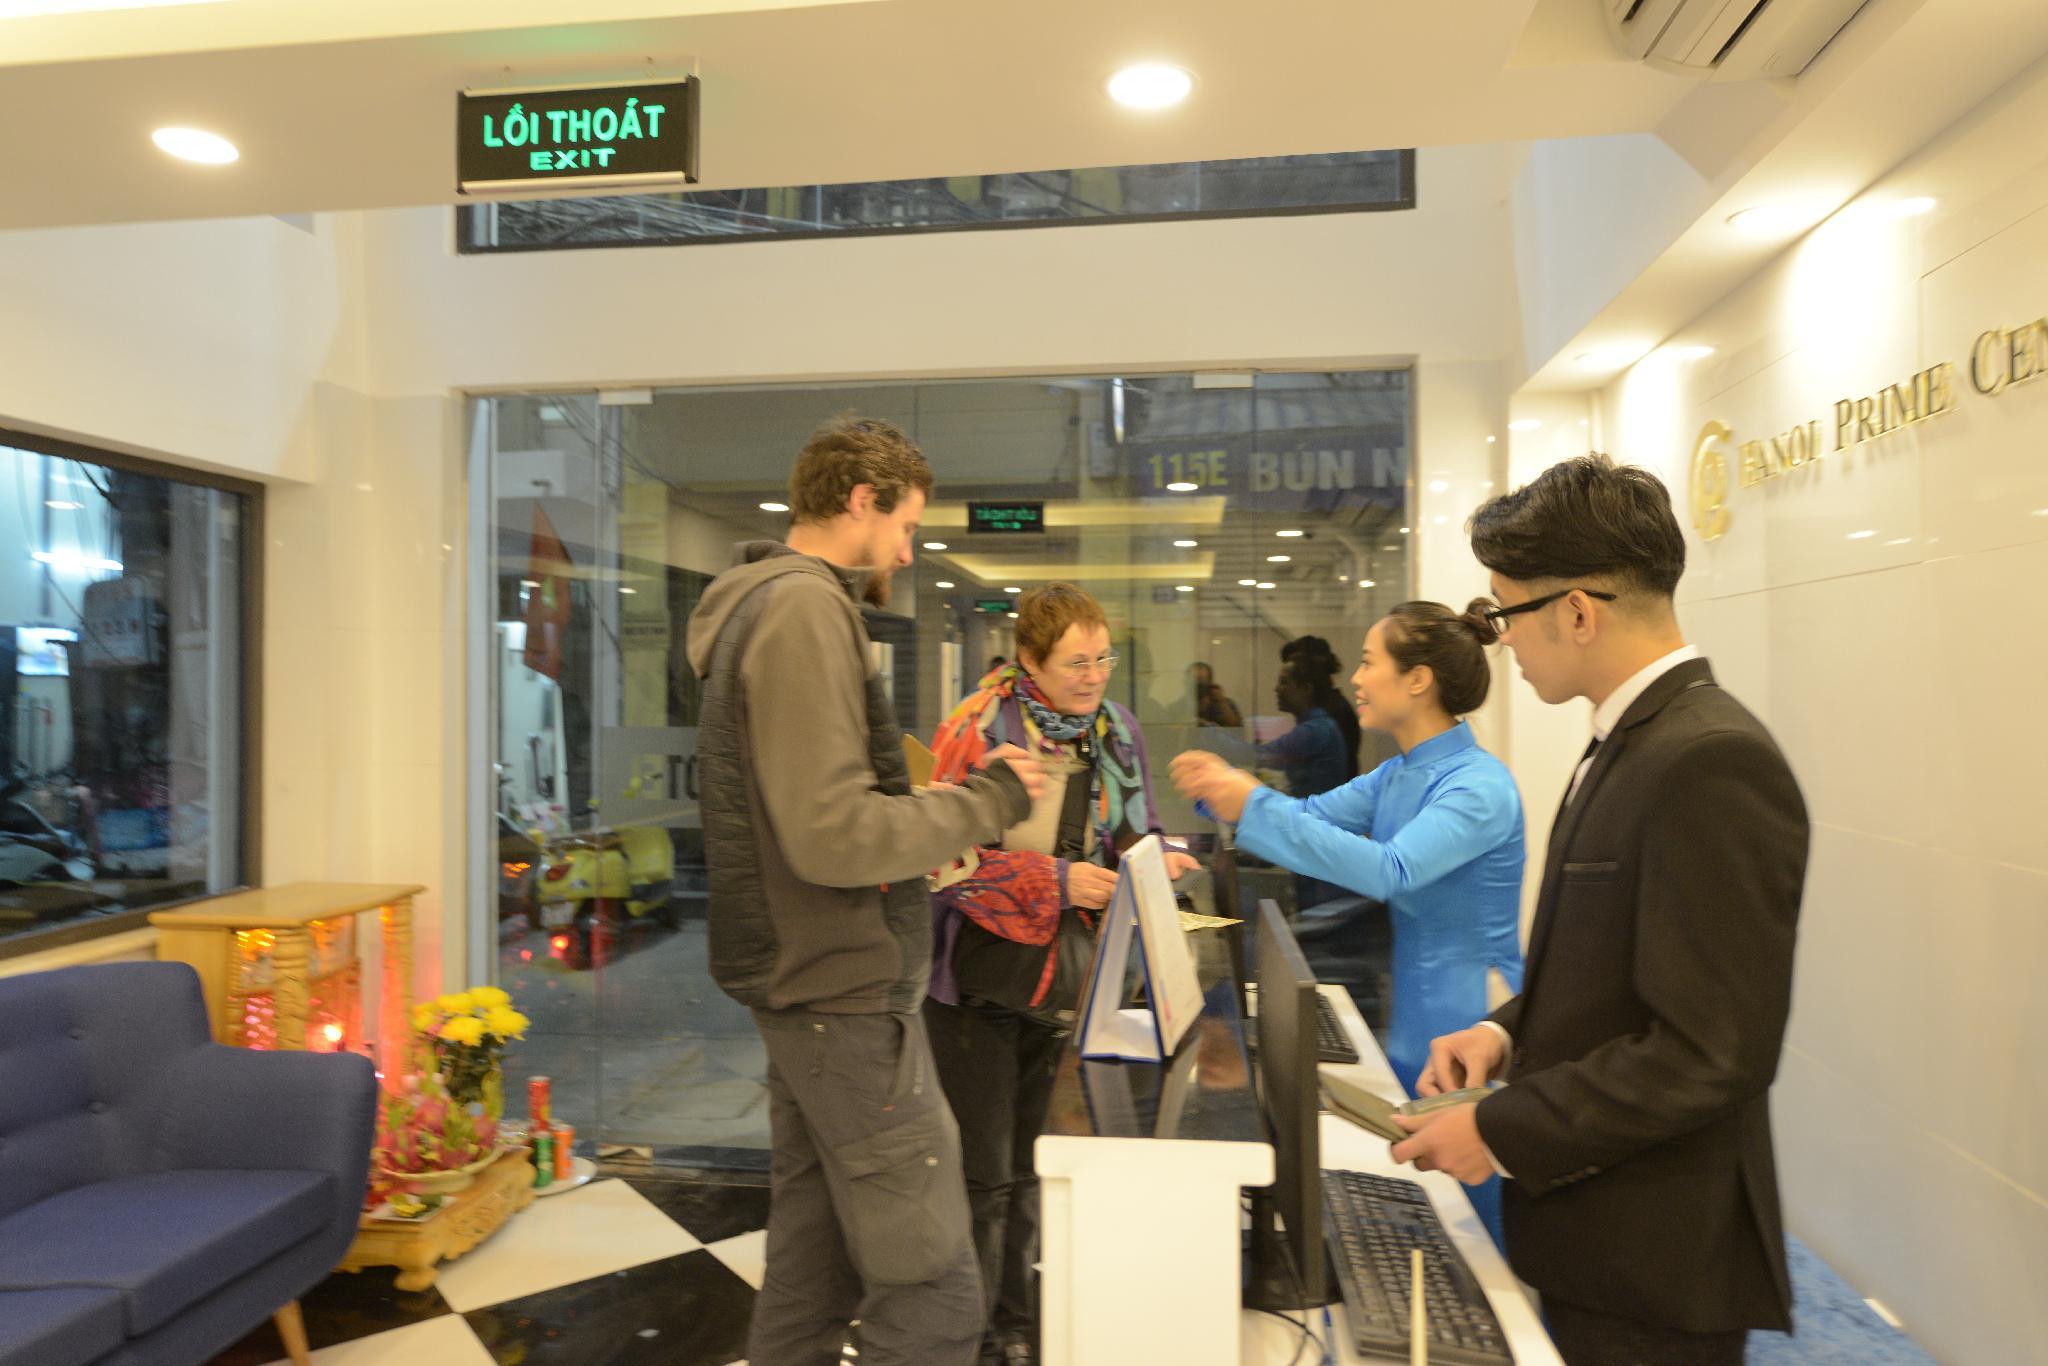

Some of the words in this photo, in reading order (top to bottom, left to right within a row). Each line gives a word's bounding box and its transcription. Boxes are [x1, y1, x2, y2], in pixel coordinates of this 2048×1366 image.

[546, 98, 665, 143] THOÁT
[530, 148, 616, 170] EXIT
[1832, 361, 1954, 452] PRIME
[1150, 451, 1228, 490] 115E
